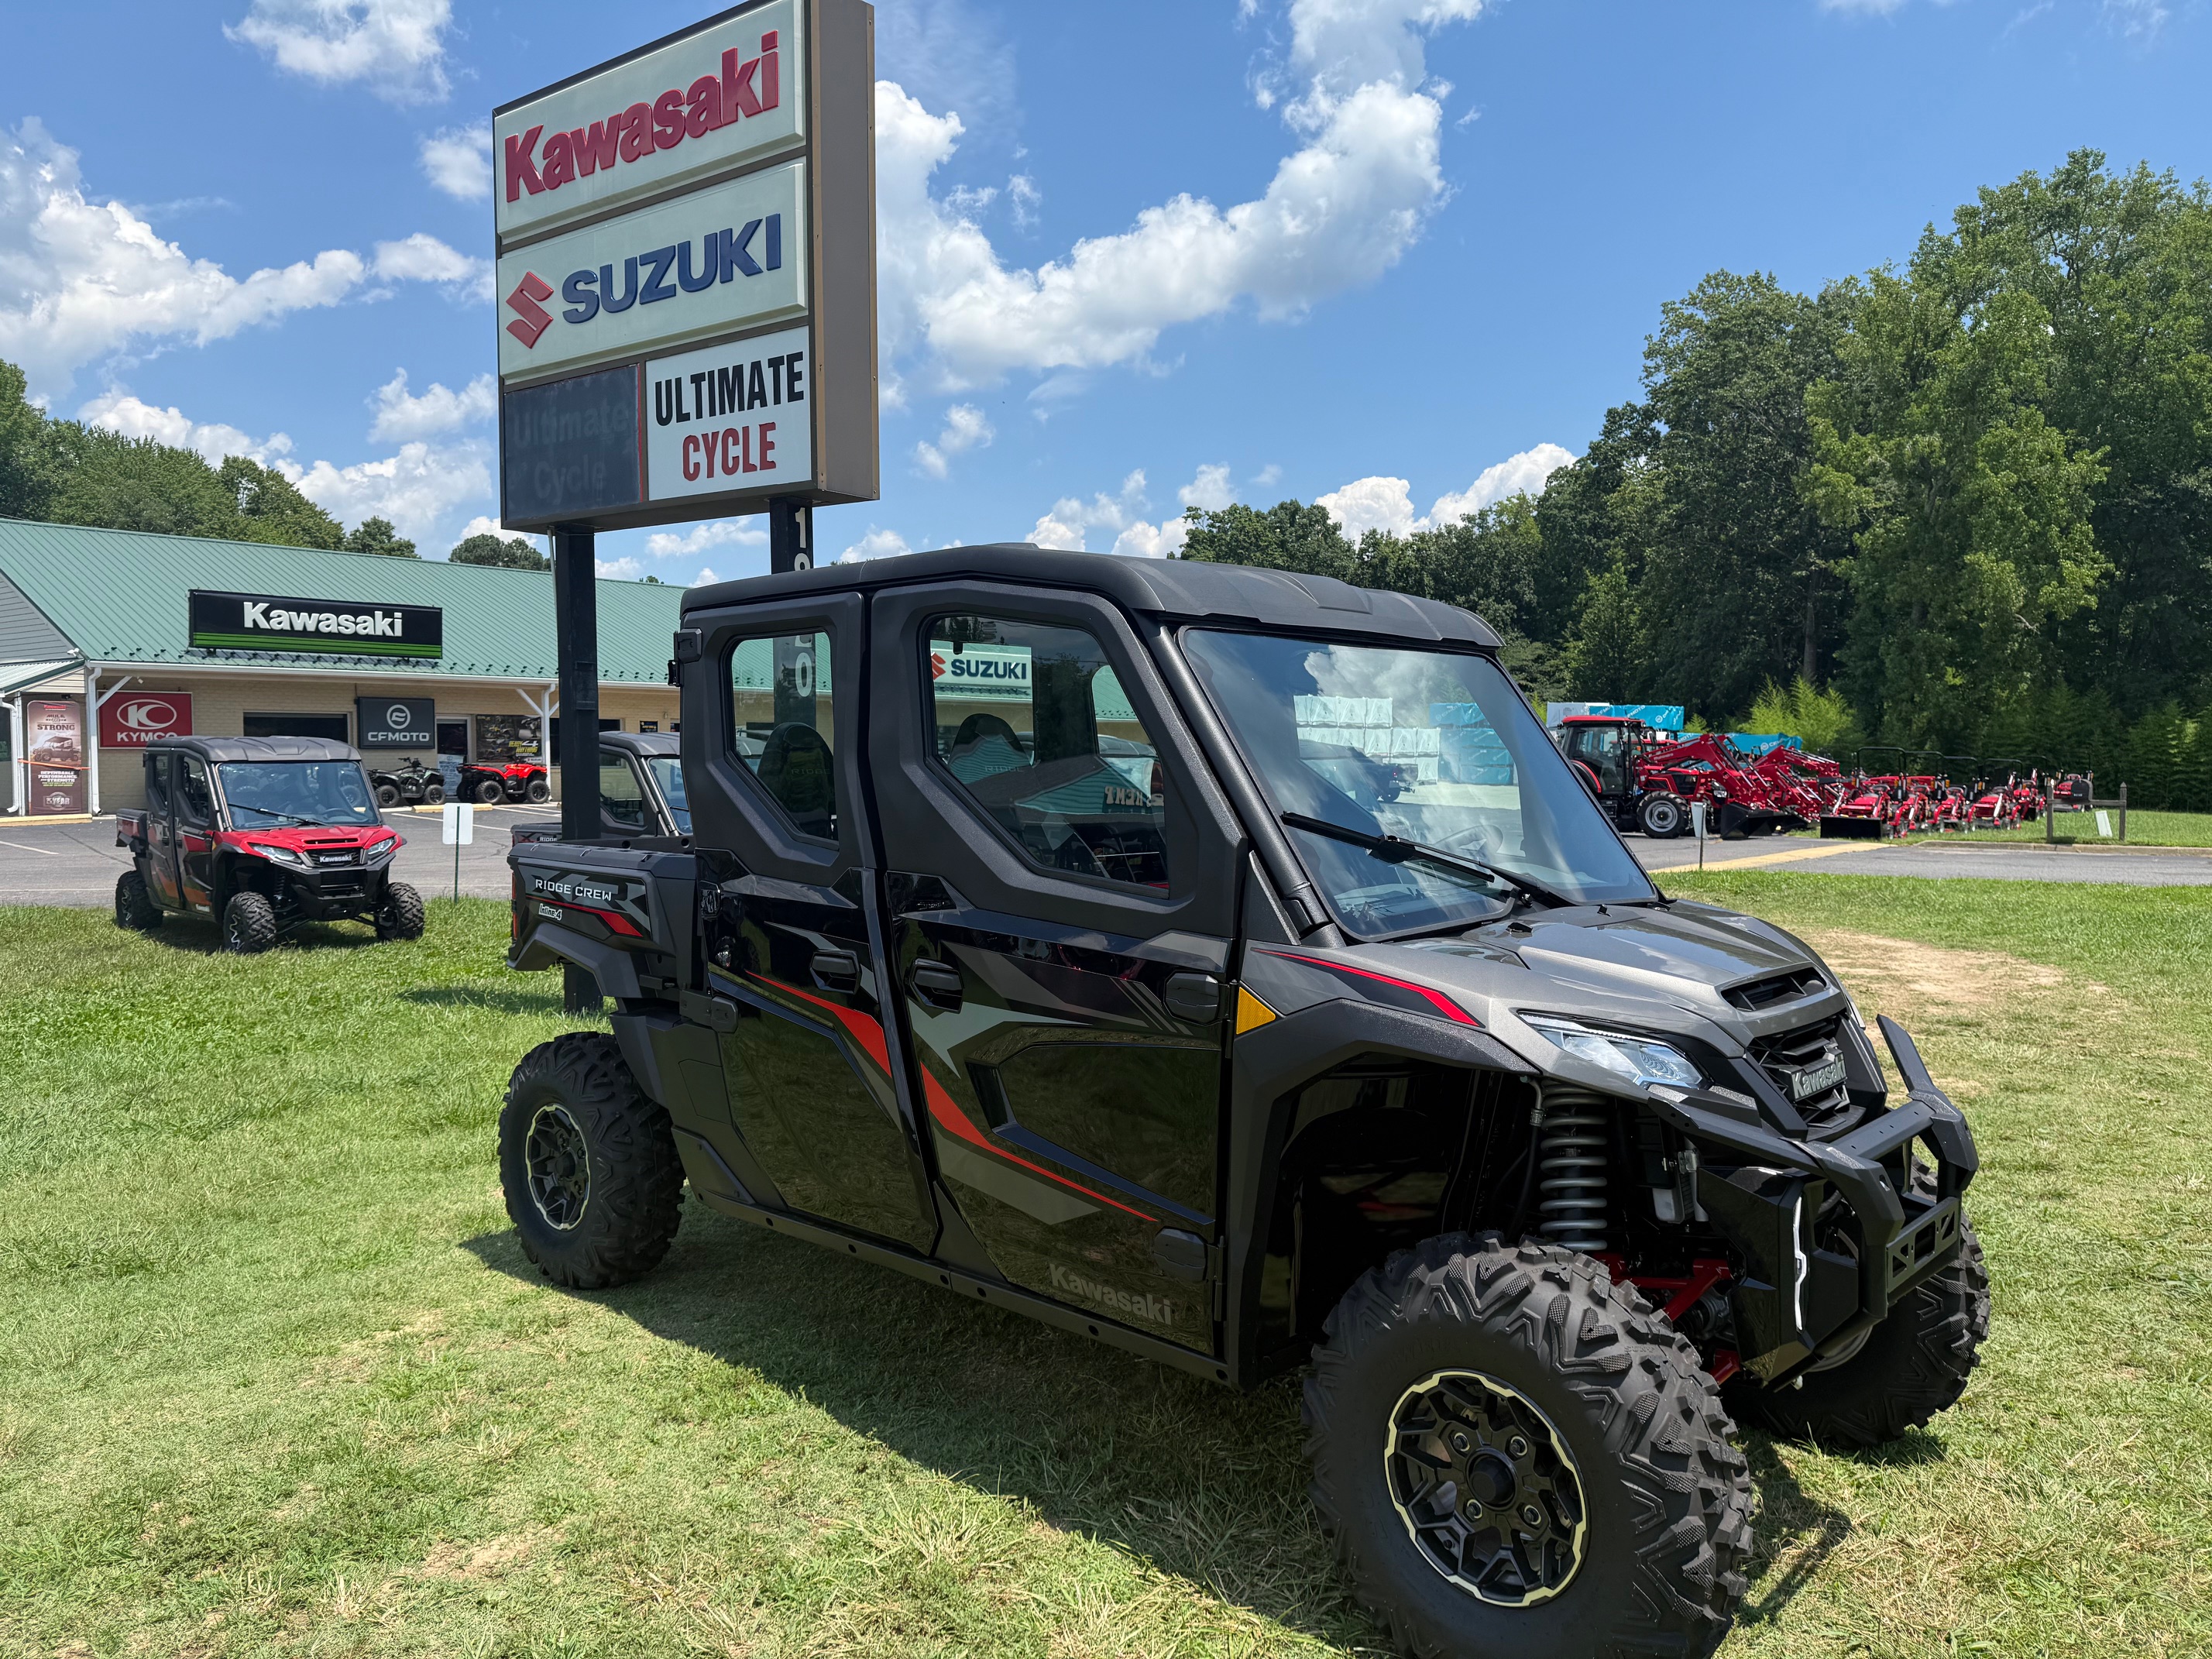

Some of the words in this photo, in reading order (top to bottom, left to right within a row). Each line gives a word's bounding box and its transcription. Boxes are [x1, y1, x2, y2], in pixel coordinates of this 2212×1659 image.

[505, 29, 778, 203] Kawasaki
[562, 213, 781, 325] SUZUKI
[654, 351, 805, 427] ULTIMATE
[514, 398, 629, 448] Ultimate
[682, 422, 777, 482] CYCLE
[534, 453, 606, 506] Cycle
[243, 601, 403, 637] Kawasaki
[950, 658, 1027, 680] SUZUKI
[367, 731, 430, 742] CFMOTO
[319, 854, 352, 864] Kawasaki
[535, 879, 572, 895] RIDGE
[575, 886, 613, 902] CREW
[1791, 1053, 1847, 1100] Kawasaki
[1049, 1263, 1172, 1326] Kawasaki
